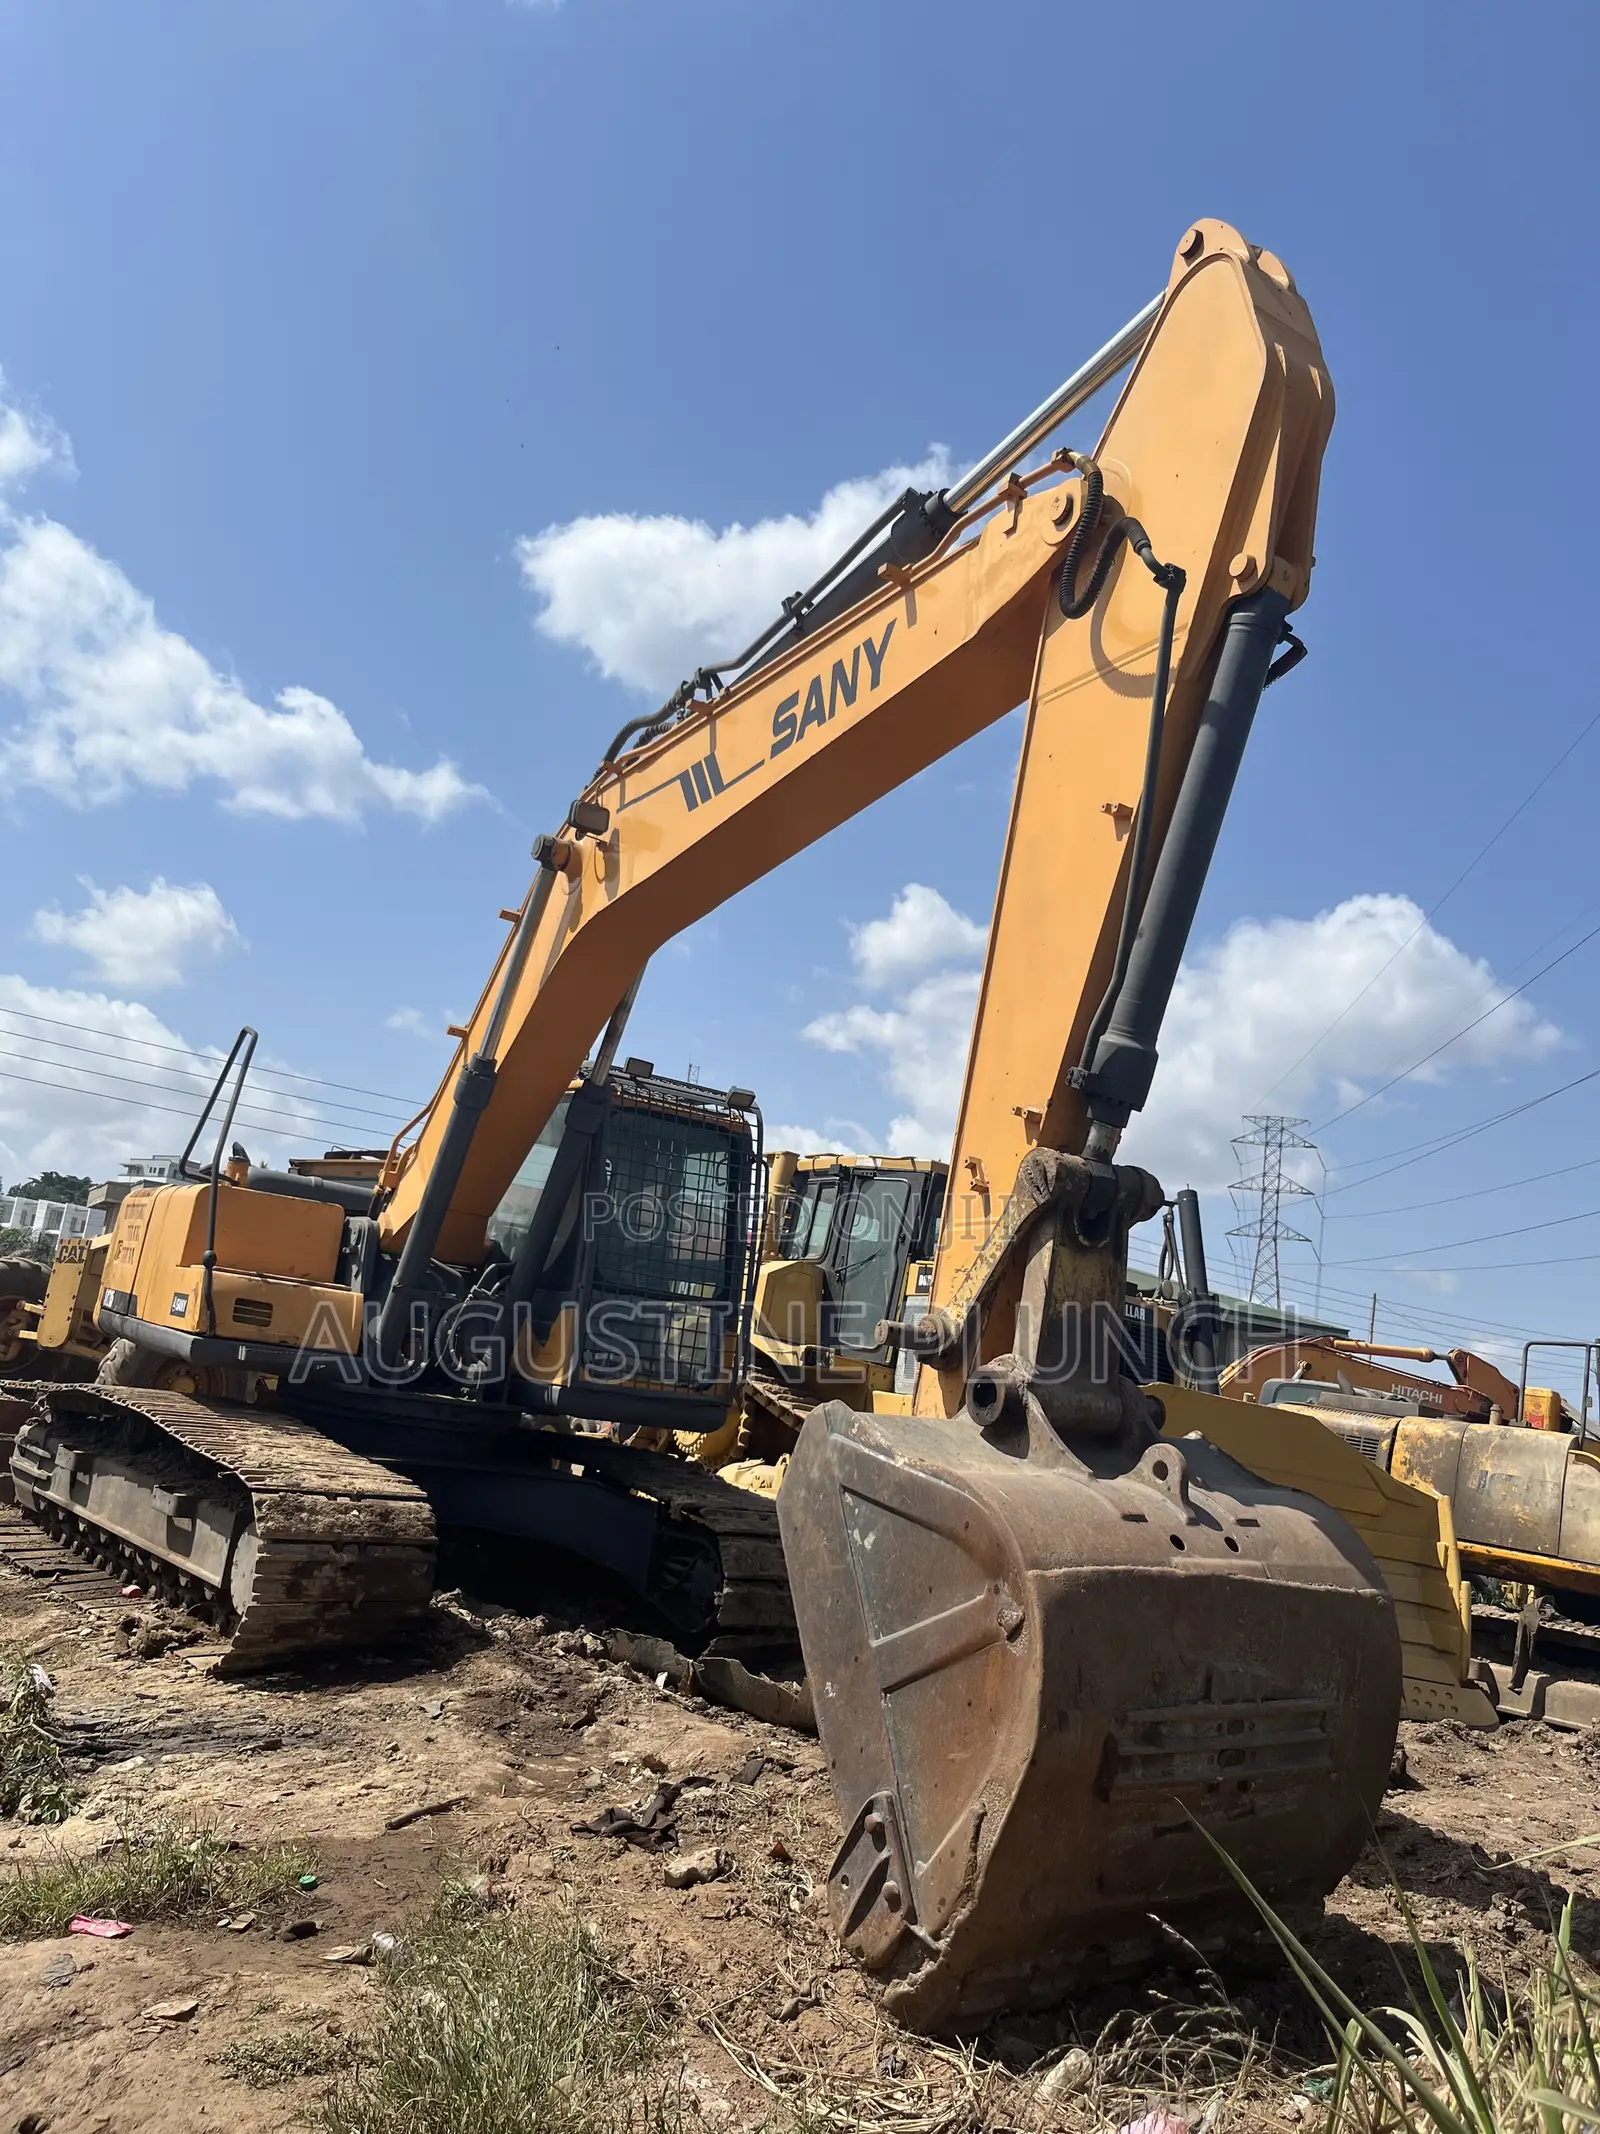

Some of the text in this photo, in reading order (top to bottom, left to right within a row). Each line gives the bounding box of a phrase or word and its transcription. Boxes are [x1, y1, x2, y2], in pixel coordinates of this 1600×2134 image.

[770, 617, 898, 761] SANY
[56, 1245, 87, 1264] CAT
[1391, 1383, 1443, 1404] HITACHI
